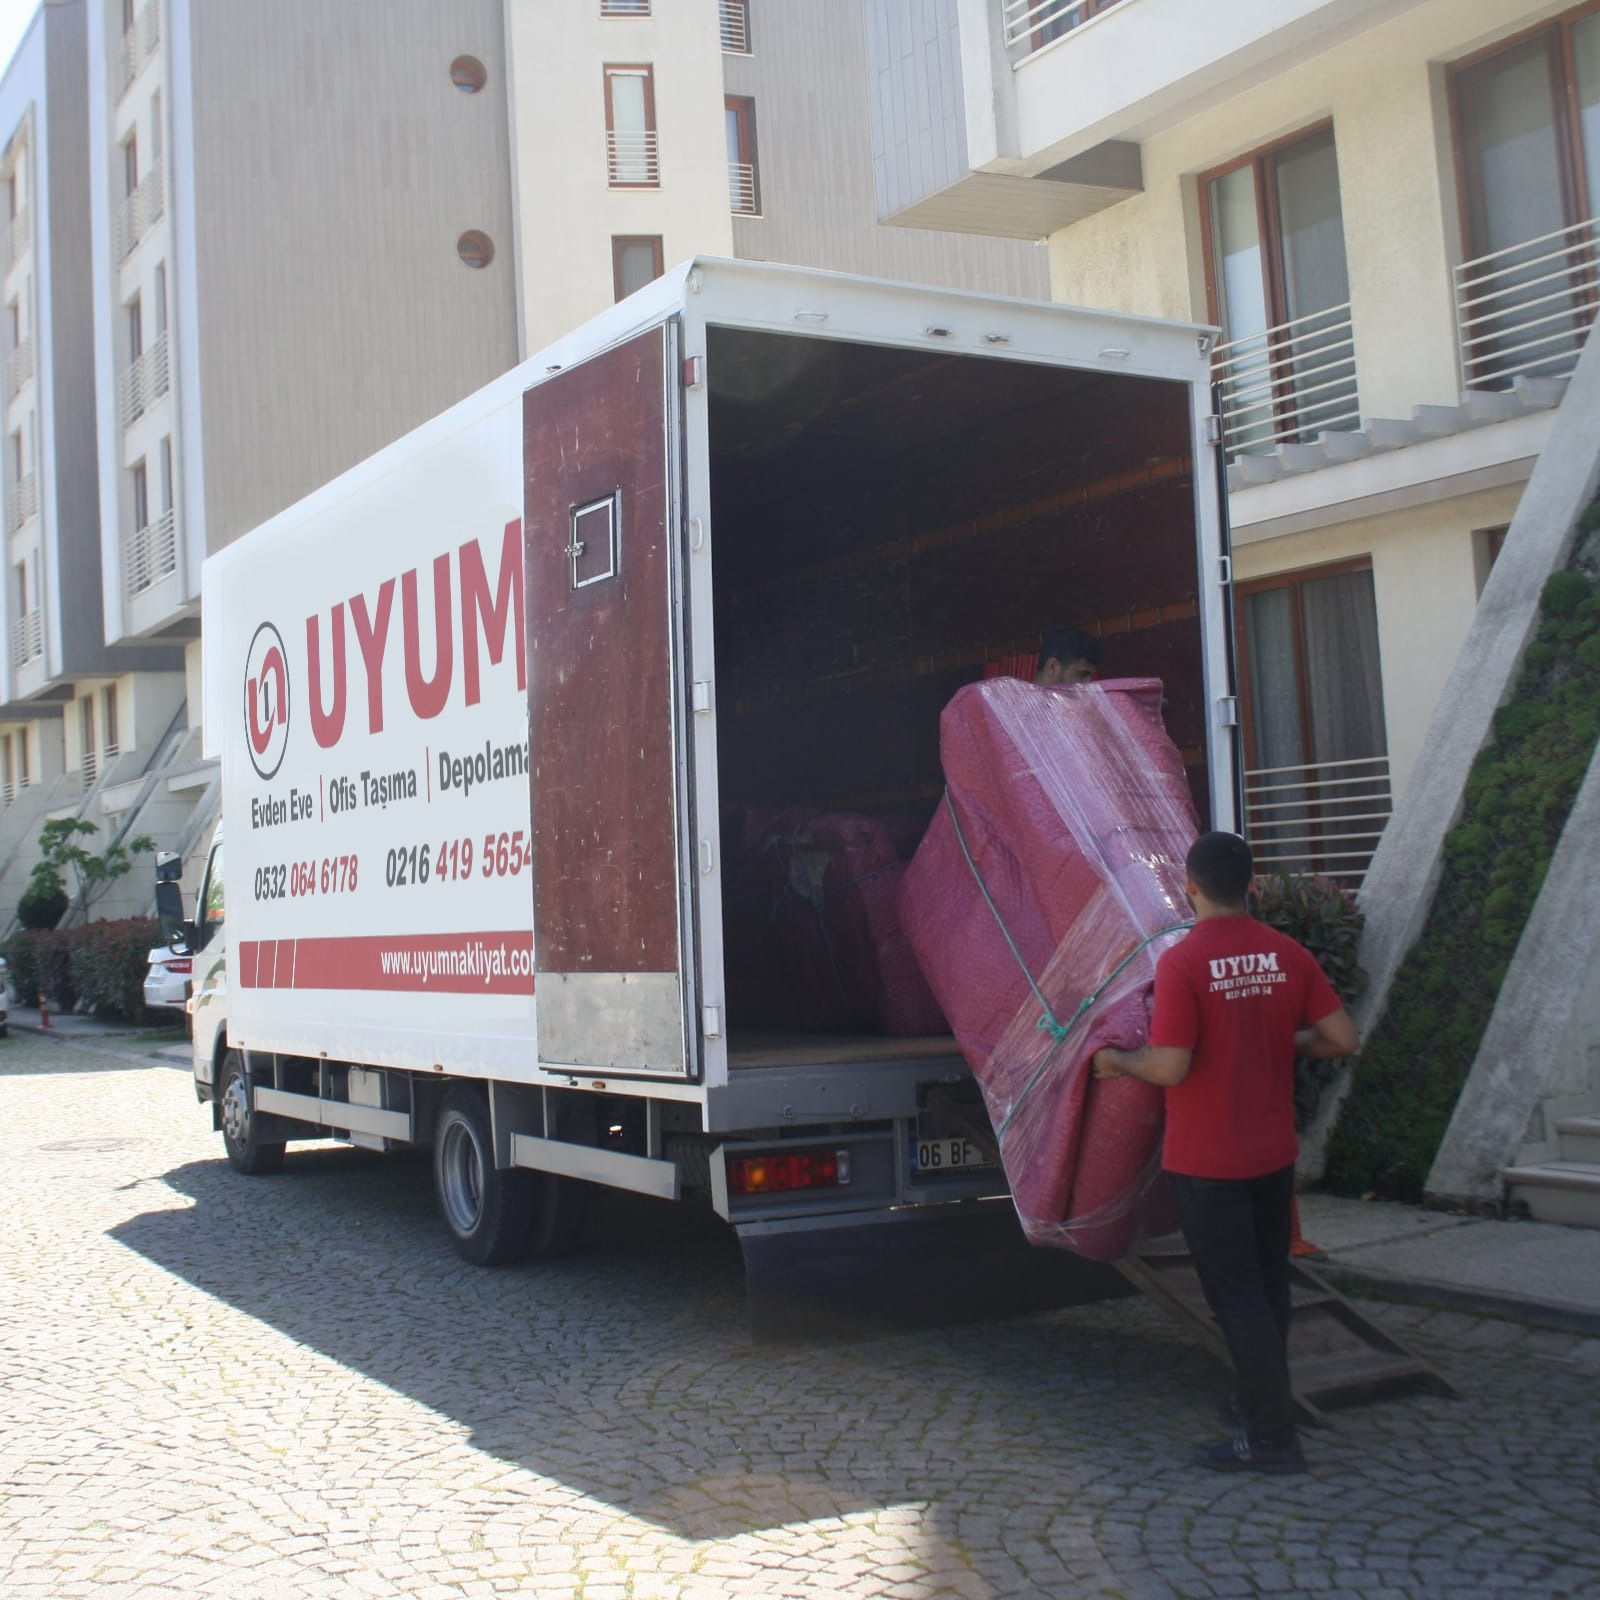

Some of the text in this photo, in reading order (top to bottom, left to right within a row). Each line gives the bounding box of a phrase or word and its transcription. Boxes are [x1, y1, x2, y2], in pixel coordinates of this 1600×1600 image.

[306, 516, 527, 748] UYUM
[251, 795, 287, 829] Evden
[290, 788, 313, 821] Eve
[329, 776, 357, 814] Ofis
[360, 769, 417, 809] Taşıma
[254, 863, 287, 901] 0532
[290, 859, 316, 898] 064
[320, 854, 359, 894] 6178
[386, 843, 430, 888] 0216
[435, 837, 474, 882] 419
[1208, 952, 1279, 979] UYUM
[920, 1143, 942, 1168] 06
